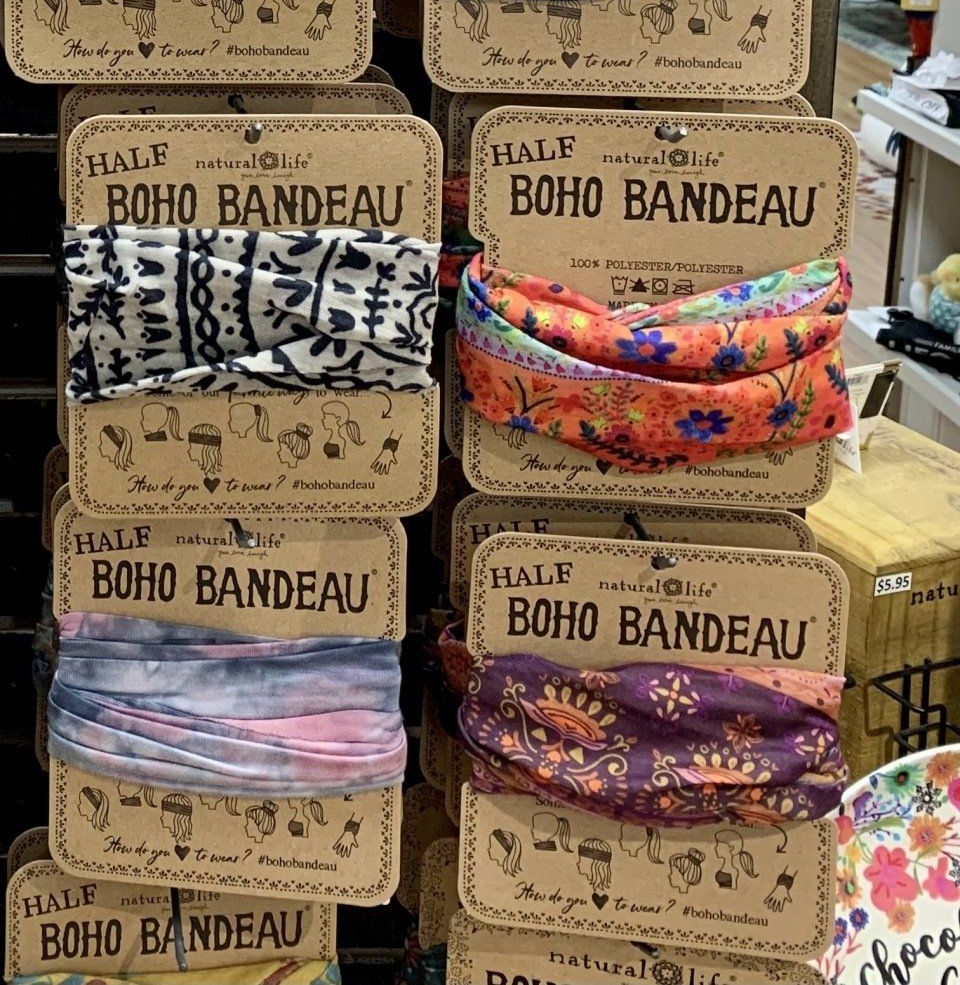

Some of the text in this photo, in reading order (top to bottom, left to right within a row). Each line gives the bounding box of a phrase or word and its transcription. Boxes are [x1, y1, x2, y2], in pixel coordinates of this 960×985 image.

[63, 39, 95, 58] How
[96, 42, 110, 56] do
[110, 47, 134, 66] you
[161, 42, 174, 56] to
[226, 45, 310, 57] #bohobandeau
[481, 48, 515, 68] How
[516, 51, 532, 66] do
[531, 56, 556, 75] you
[585, 52, 599, 66] to
[654, 56, 742, 69] #bohobandeau
[85, 143, 169, 177] HALF
[195, 153, 258, 170] natural
[491, 136, 576, 166] HALF
[602, 152, 665, 166] natural
[106, 183, 196, 224] BOHO
[510, 174, 603, 217] BOHO
[571, 259, 743, 275] 100% POLYESTER/POLYESTER
[520, 453, 551, 473] How
[552, 457, 567, 471] do
[567, 461, 592, 478] you
[685, 467, 769, 479] #bohobandeau
[127, 474, 159, 493] How
[159, 477, 175, 492] do
[174, 481, 199, 501] you
[227, 477, 240, 492] to
[292, 479, 374, 490] #bohobandeau
[74, 526, 151, 555] HALF
[176, 532, 235, 547] natural
[91, 559, 176, 602] BOHO
[490, 562, 573, 589] HALF
[599, 579, 660, 594] natural
[876, 575, 910, 594] $5.95
[507, 595, 598, 641] BOHO
[103, 835, 135, 855] How
[135, 841, 150, 857] do
[149, 846, 172, 865] you
[195, 846, 208, 861] to
[258, 856, 337, 872] #bohobandeau
[22, 884, 97, 918] HALF
[515, 881, 547, 902] How
[547, 888, 563, 904] do
[562, 894, 588, 914] you
[613, 895, 628, 909] to
[683, 905, 768, 927] #bohobandeau
[41, 919, 121, 961] BOHO
